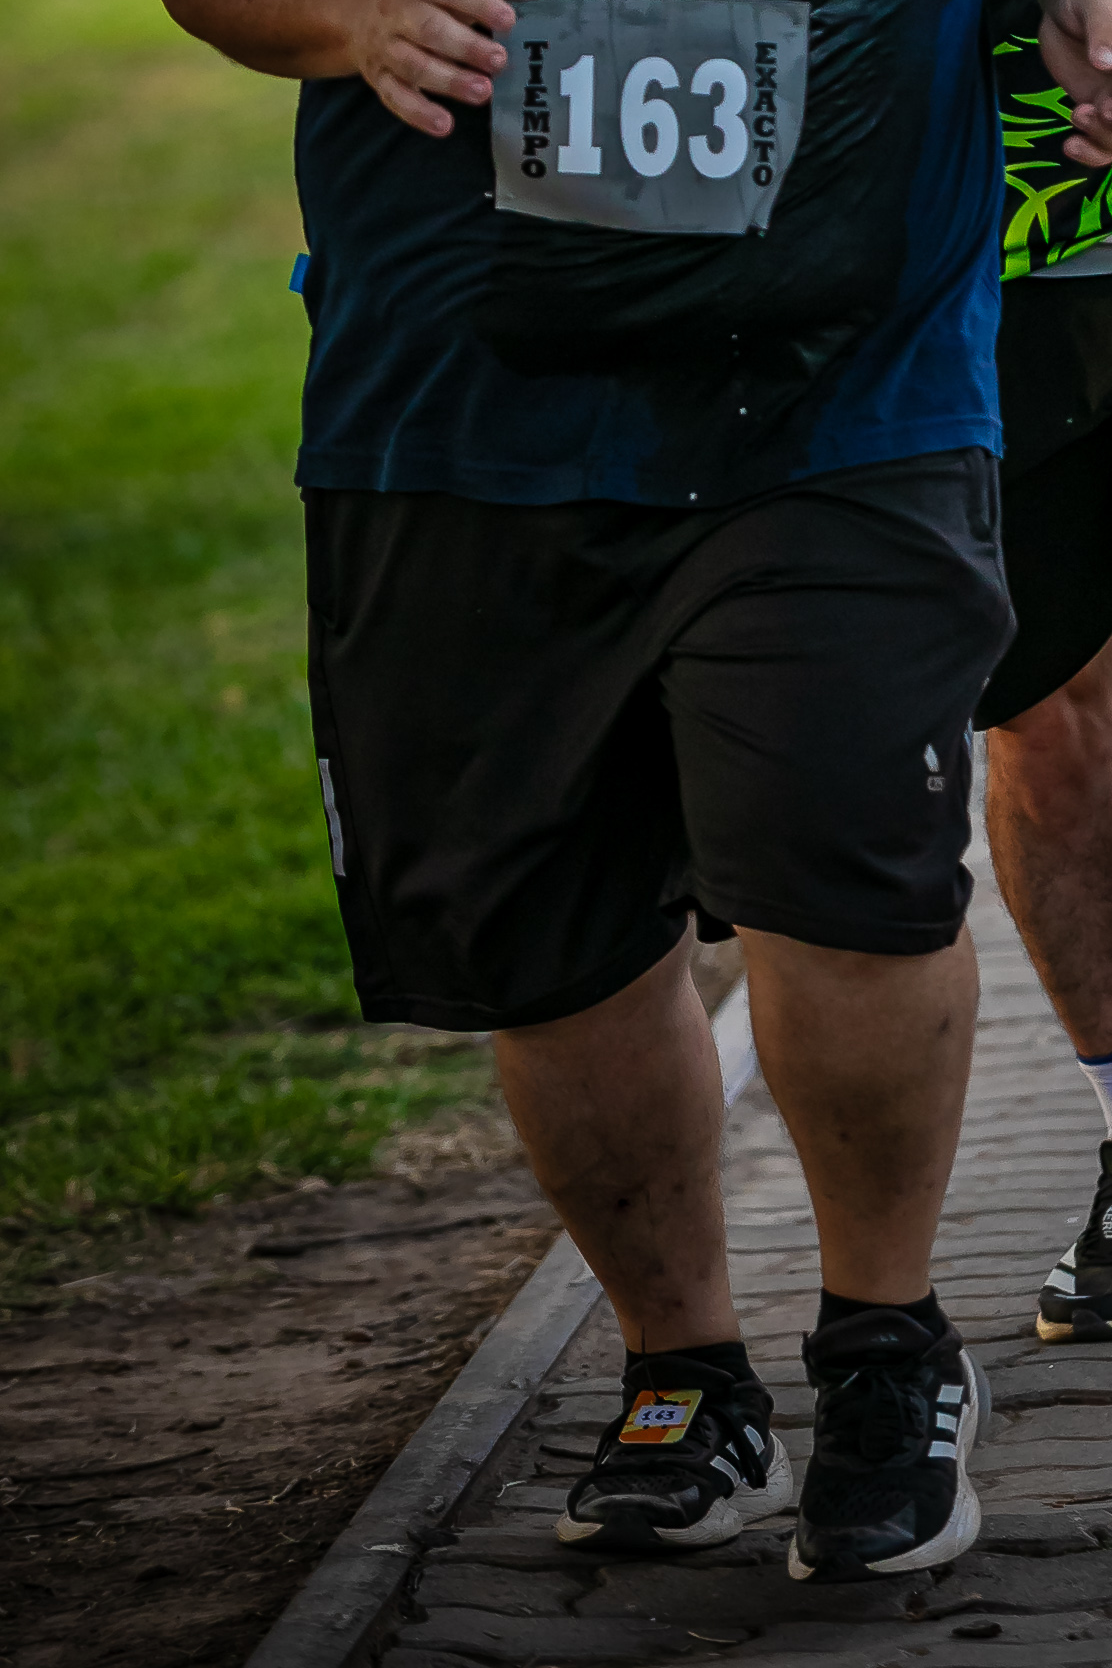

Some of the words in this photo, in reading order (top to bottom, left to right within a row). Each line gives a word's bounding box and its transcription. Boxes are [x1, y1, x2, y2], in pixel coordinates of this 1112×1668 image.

[521, 40, 549, 179] TIEMPO
[557, 54, 748, 179] 163
[752, 42, 777, 187] EXACTO
[641, 1410, 676, 1421] 163
